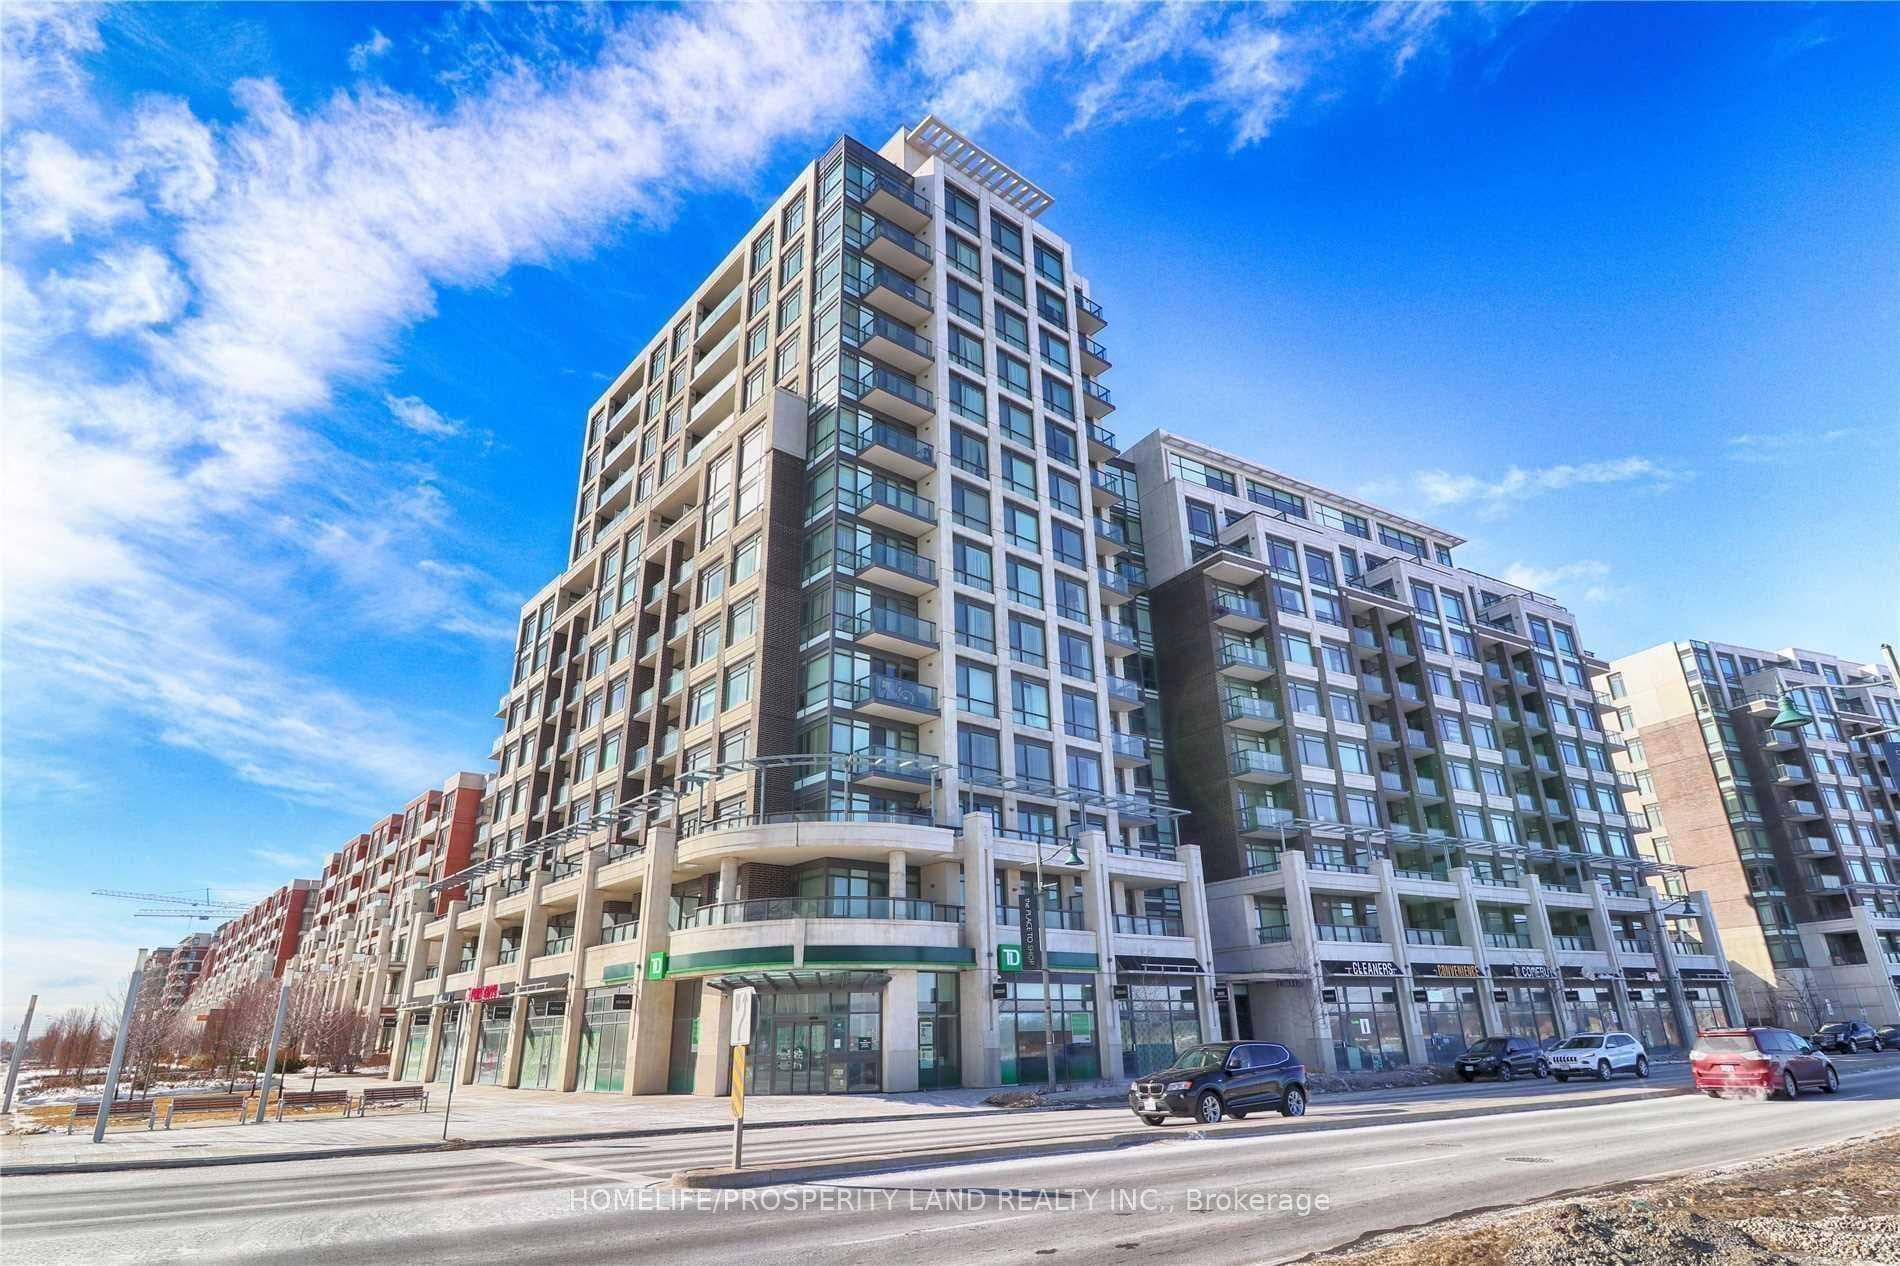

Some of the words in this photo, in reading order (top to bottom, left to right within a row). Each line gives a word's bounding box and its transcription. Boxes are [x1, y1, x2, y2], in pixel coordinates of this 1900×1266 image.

[1026, 931, 1034, 943] TO
[1002, 948, 1020, 966] TD
[1352, 961, 1393, 976] CLEANERS
